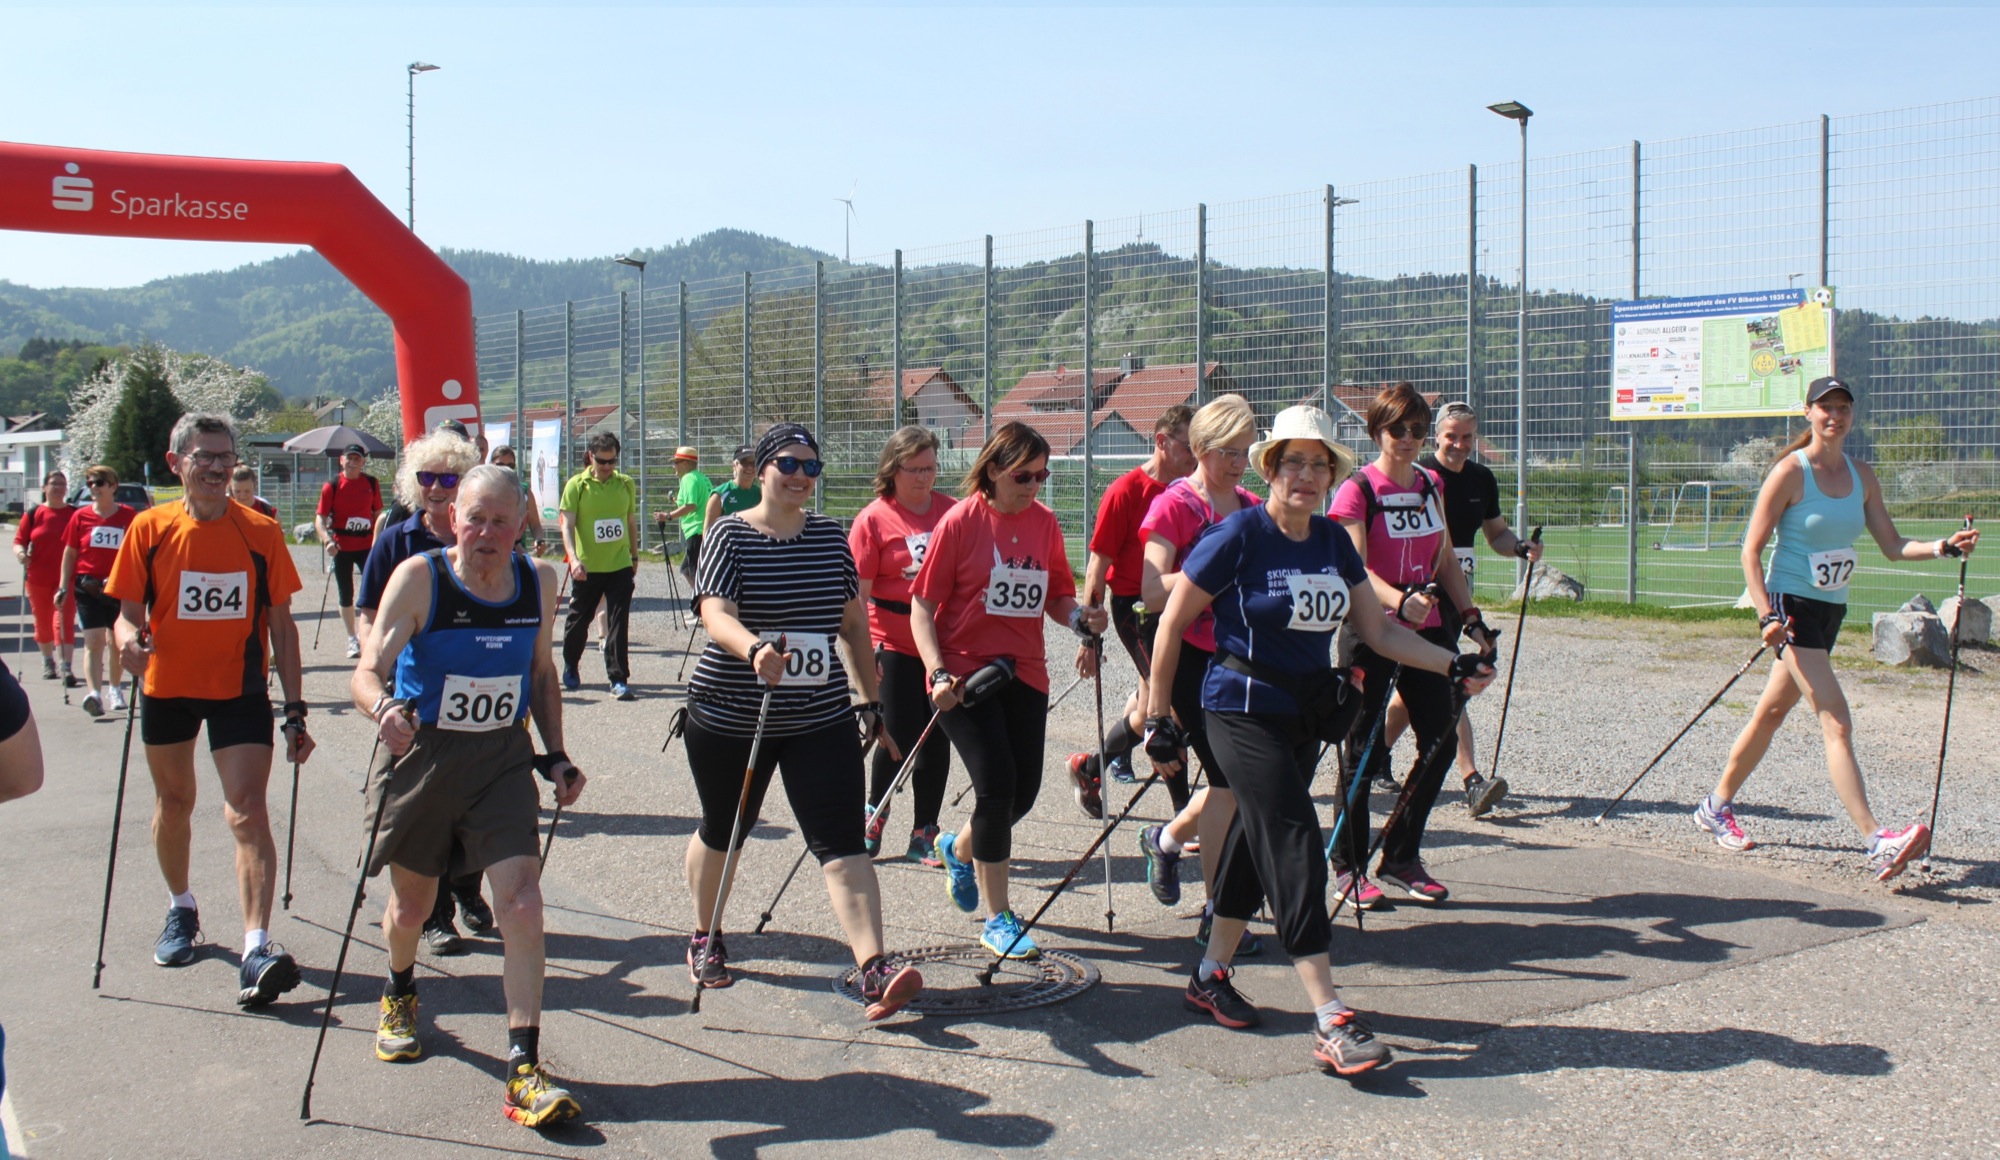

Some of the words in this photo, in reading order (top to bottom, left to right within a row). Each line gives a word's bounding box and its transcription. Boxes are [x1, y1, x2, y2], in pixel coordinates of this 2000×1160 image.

[110, 190, 249, 220] Sparkasse
[1614, 303, 1661, 313] Sponsorentafel
[1662, 300, 1713, 310] Kunstrasenplatz
[597, 524, 622, 539] 366
[1390, 505, 1434, 531] 361
[95, 532, 118, 545] 311
[1458, 557, 1474, 573] 73
[1817, 559, 1854, 586] 372
[183, 585, 242, 613] 364
[992, 581, 1042, 610] 359
[1299, 590, 1345, 622] 302
[785, 647, 824, 677] 08
[446, 692, 514, 723] 306
